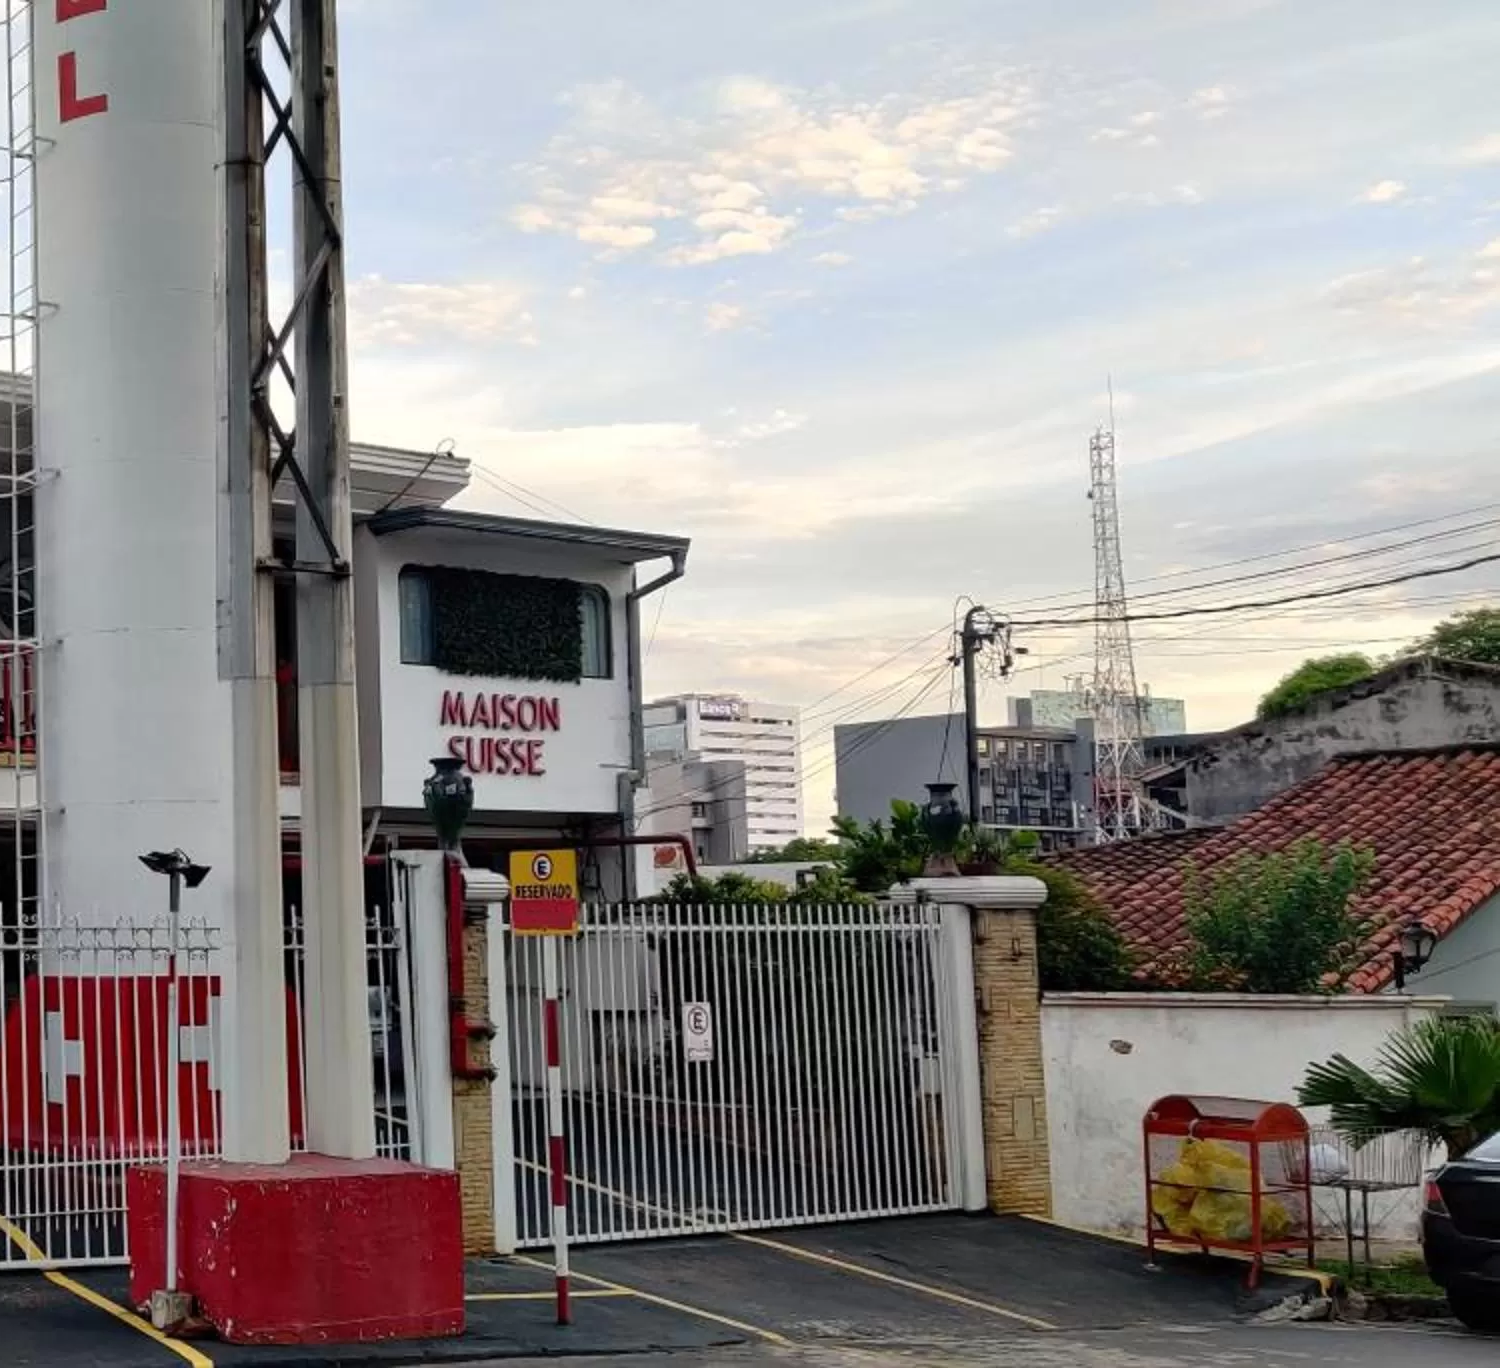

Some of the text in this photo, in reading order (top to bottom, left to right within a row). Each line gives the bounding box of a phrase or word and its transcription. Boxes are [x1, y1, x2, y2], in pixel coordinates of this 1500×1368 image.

[56, 0, 108, 124] L
[440, 690, 561, 732] MAISON
[448, 735, 546, 776] SUISSE
[515, 884, 572, 899] RESERVADO
